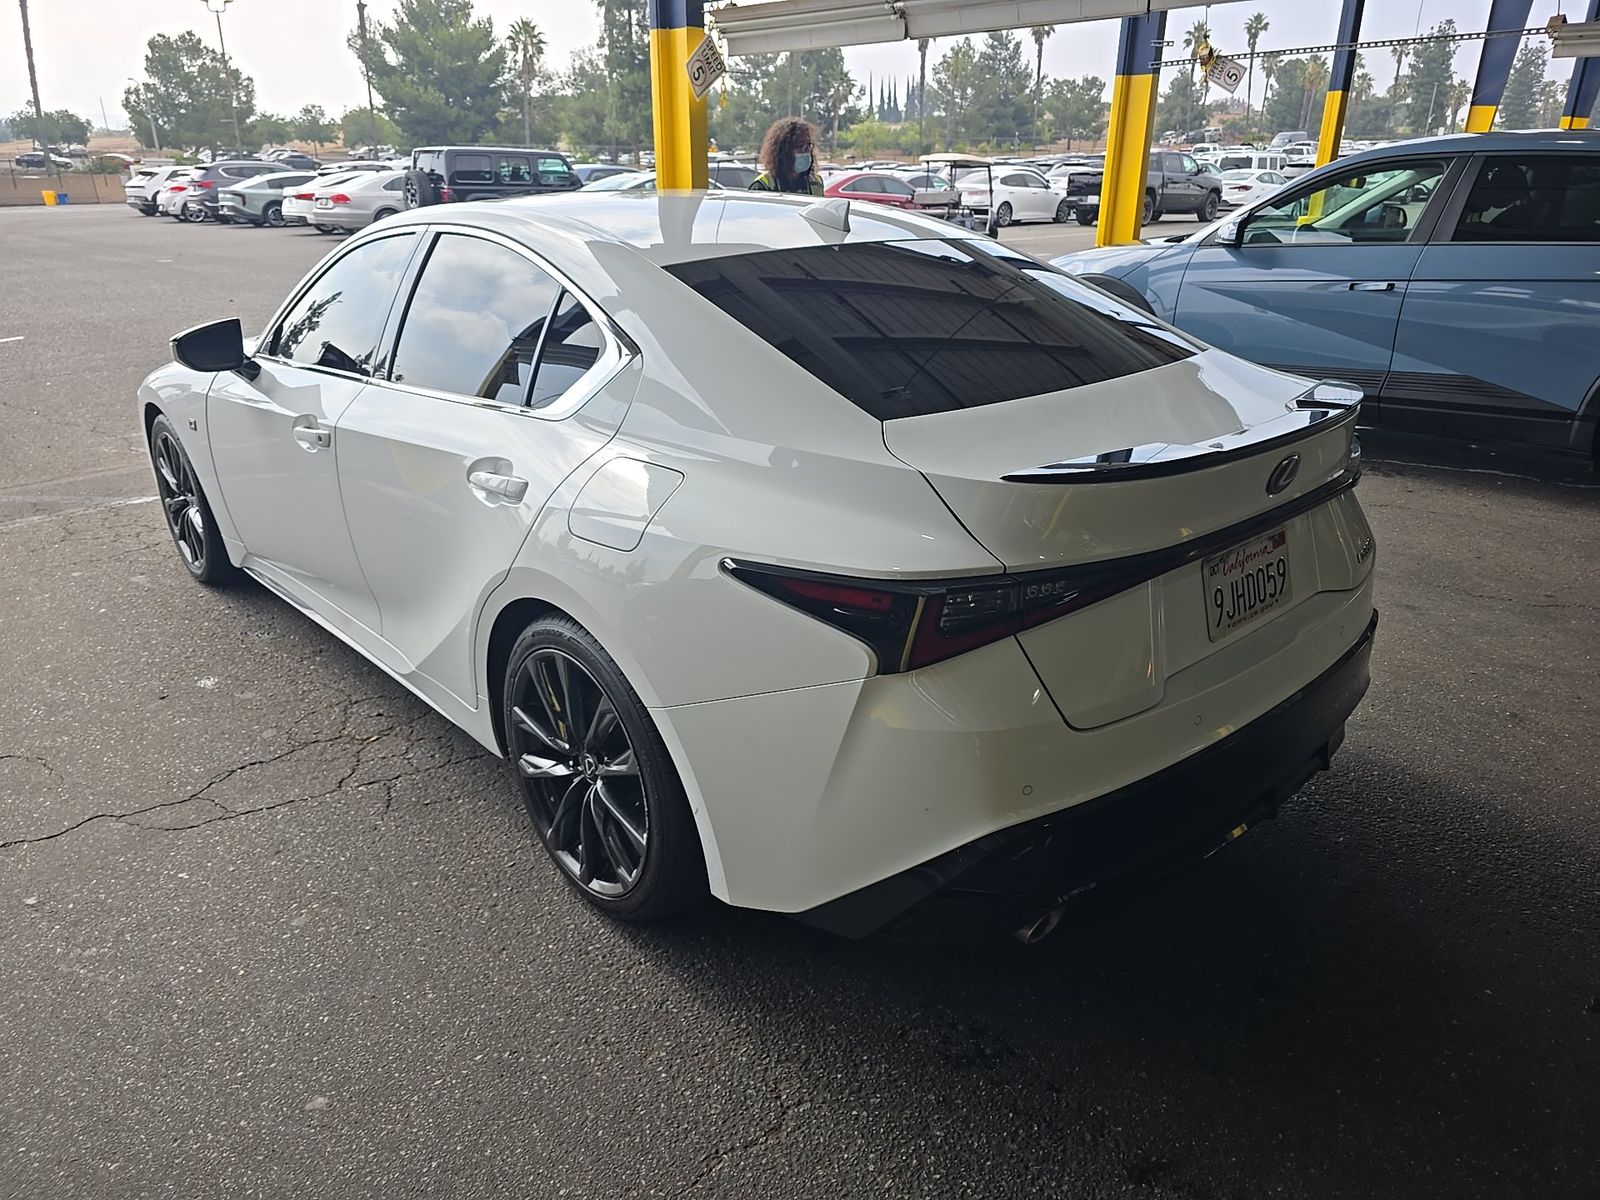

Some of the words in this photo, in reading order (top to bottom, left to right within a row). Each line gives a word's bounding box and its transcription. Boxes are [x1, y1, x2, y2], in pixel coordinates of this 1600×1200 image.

[701, 48, 716, 74] LIMIT
[706, 40, 722, 70] SPEED
[693, 65, 704, 81] 5
[1209, 60, 1221, 79] SPEE
[1215, 61, 1228, 80] LIMIT
[1227, 70, 1238, 82] 5
[1222, 547, 1274, 577] California
[1214, 557, 1286, 628] 9JHD059
